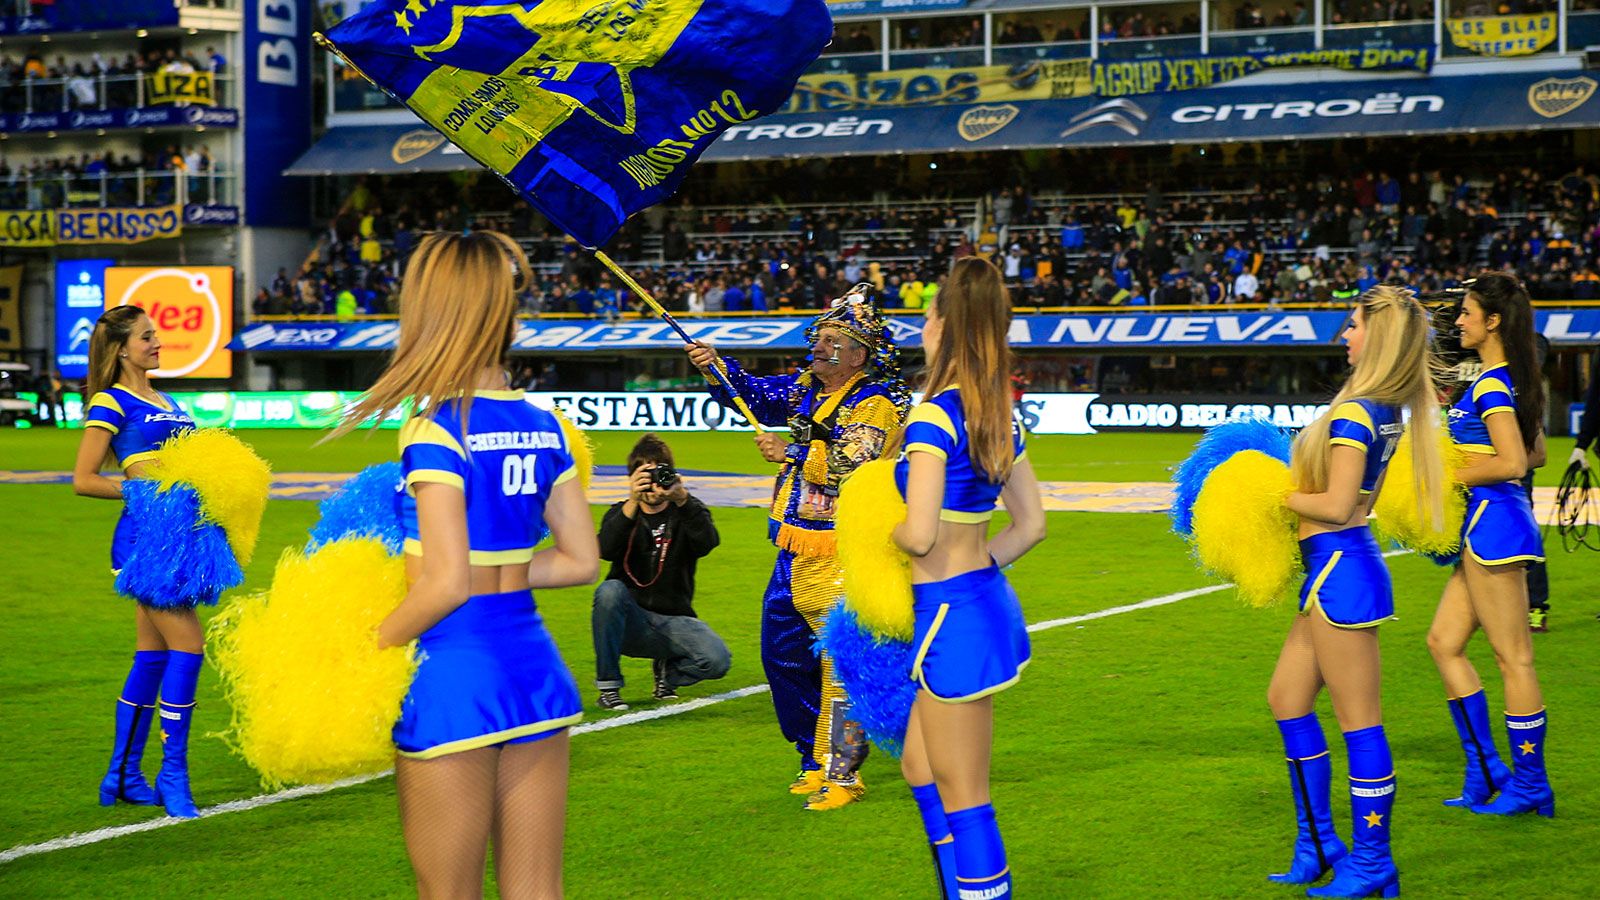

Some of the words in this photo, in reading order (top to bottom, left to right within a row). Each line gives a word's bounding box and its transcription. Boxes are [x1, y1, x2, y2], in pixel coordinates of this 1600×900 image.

[1094, 61, 1162, 97] AGRUP
[710, 89, 759, 123] 12
[721, 115, 894, 142] TROËN
[60, 211, 177, 240] BERISSO
[273, 328, 338, 344] EXO
[1048, 315, 1317, 343] NUEVA
[1089, 403, 1178, 427] RADIO
[502, 454, 538, 496] 01
